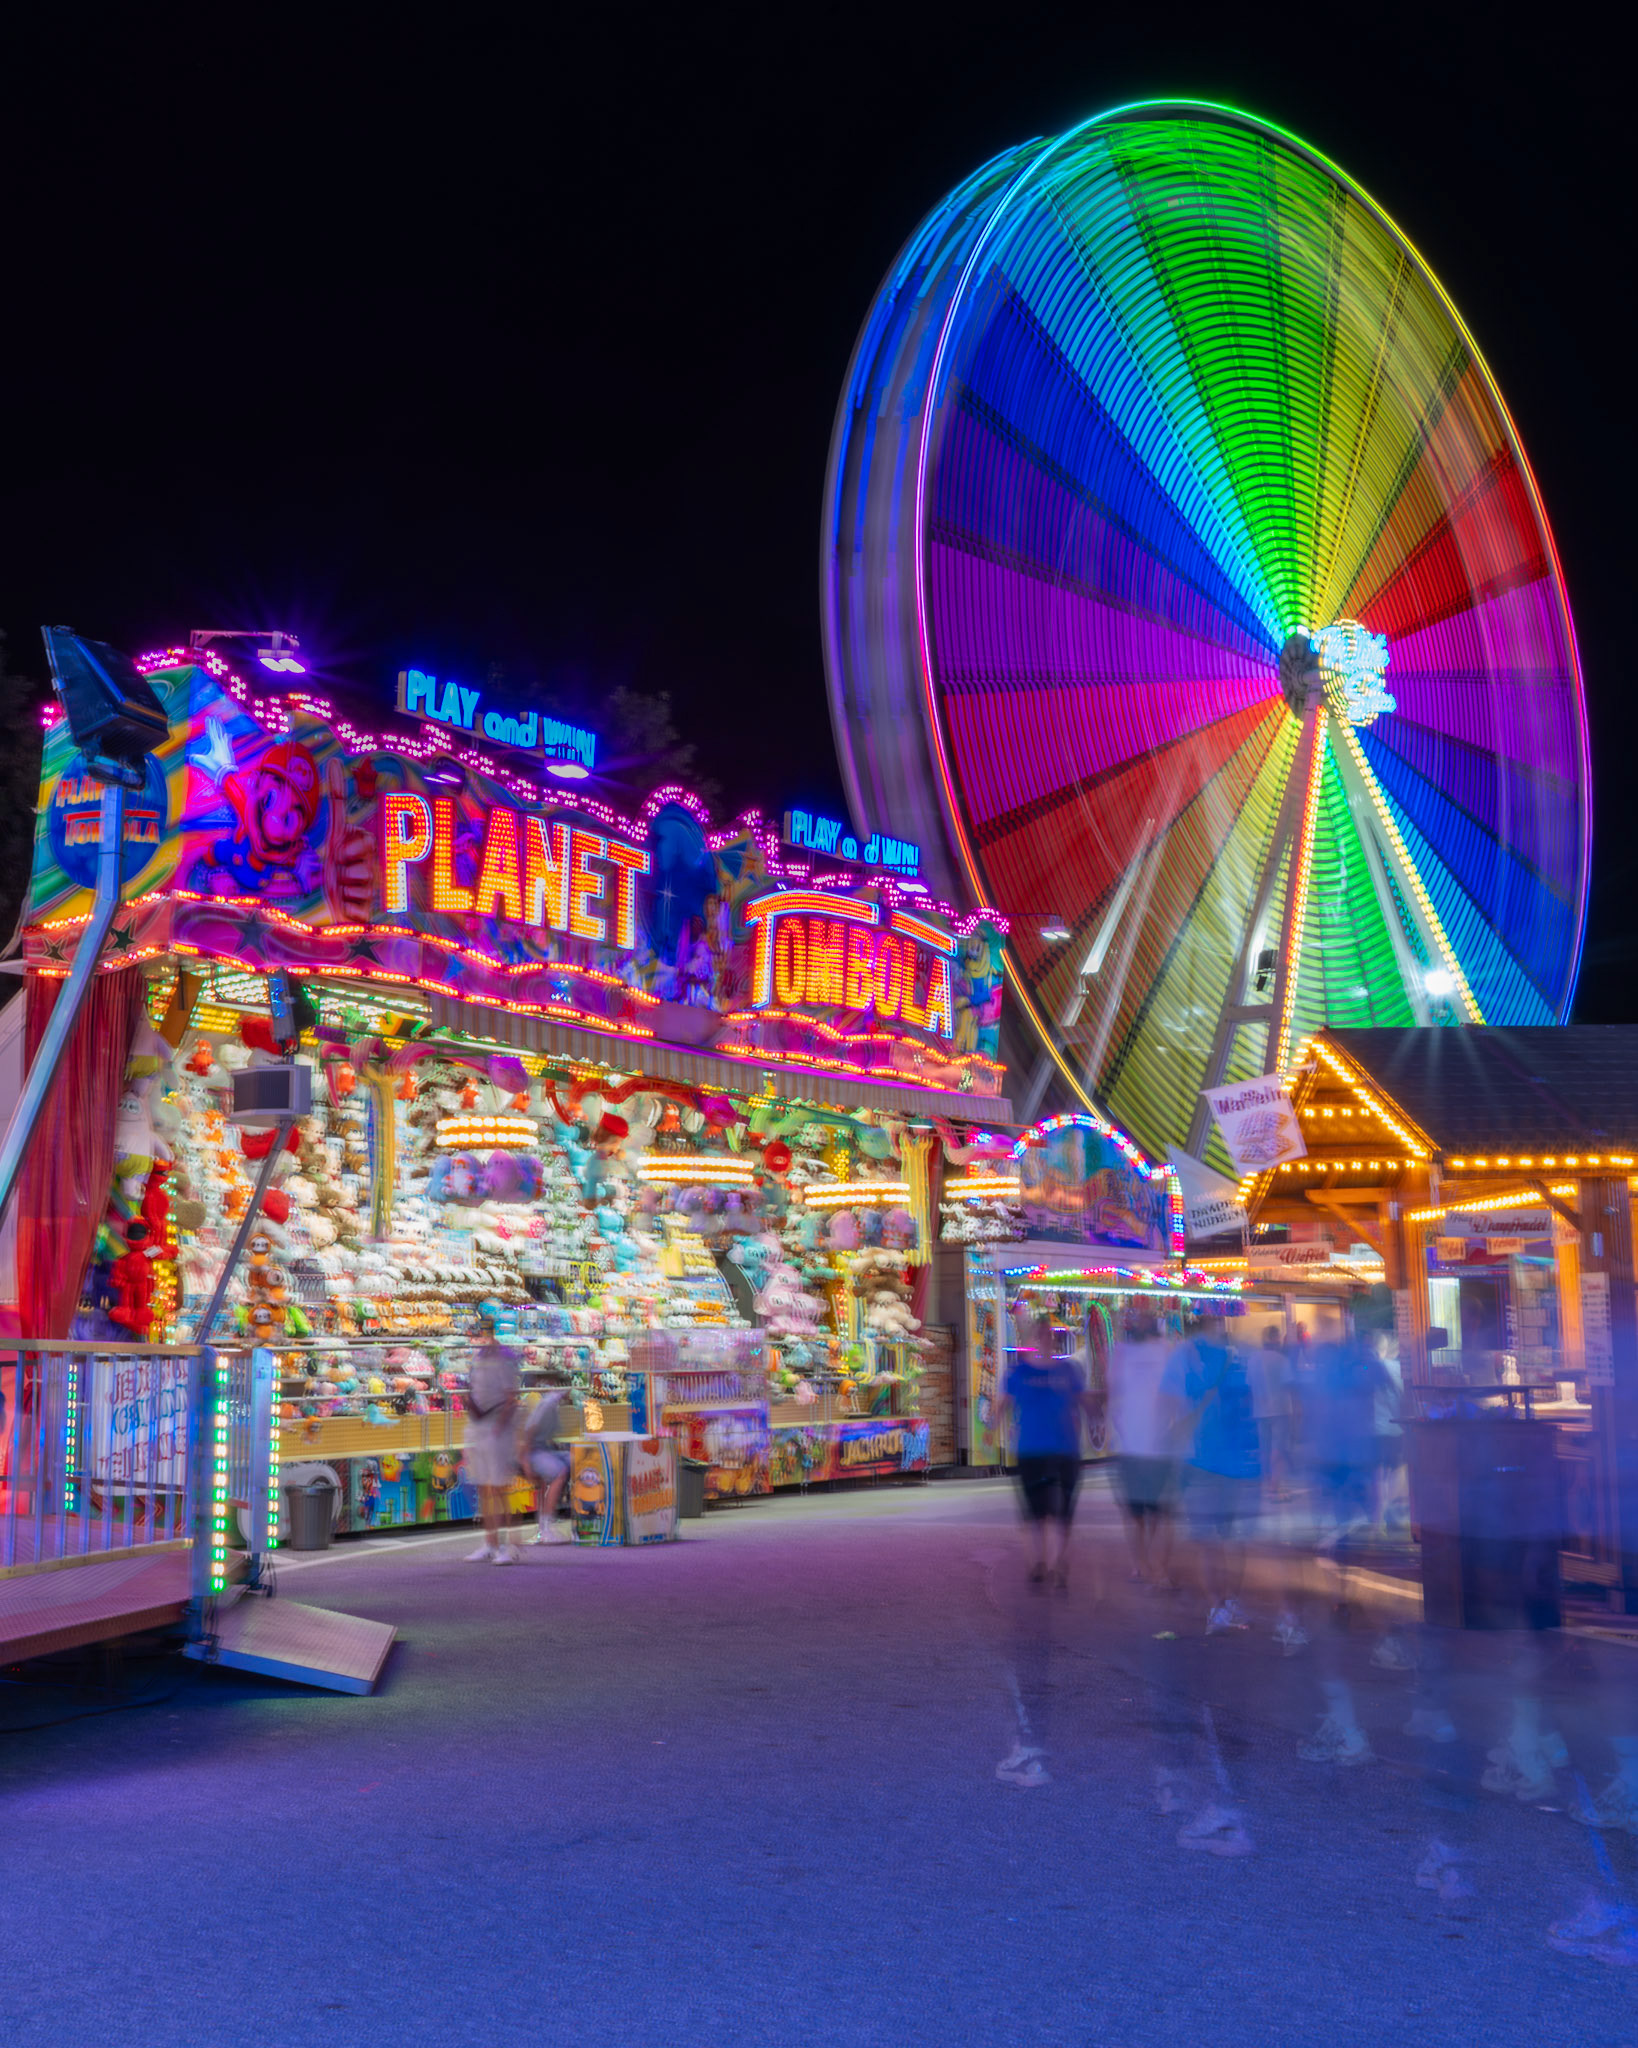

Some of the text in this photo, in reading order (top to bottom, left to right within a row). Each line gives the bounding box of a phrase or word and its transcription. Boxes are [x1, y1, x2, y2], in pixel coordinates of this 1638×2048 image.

[406, 669, 596, 769] PLAY and WIN
[385, 792, 651, 951] PLANET
[791, 809, 842, 856] PLAY
[745, 889, 958, 1039] TOMBOLA
[840, 1429, 904, 1467] JACKPOT
